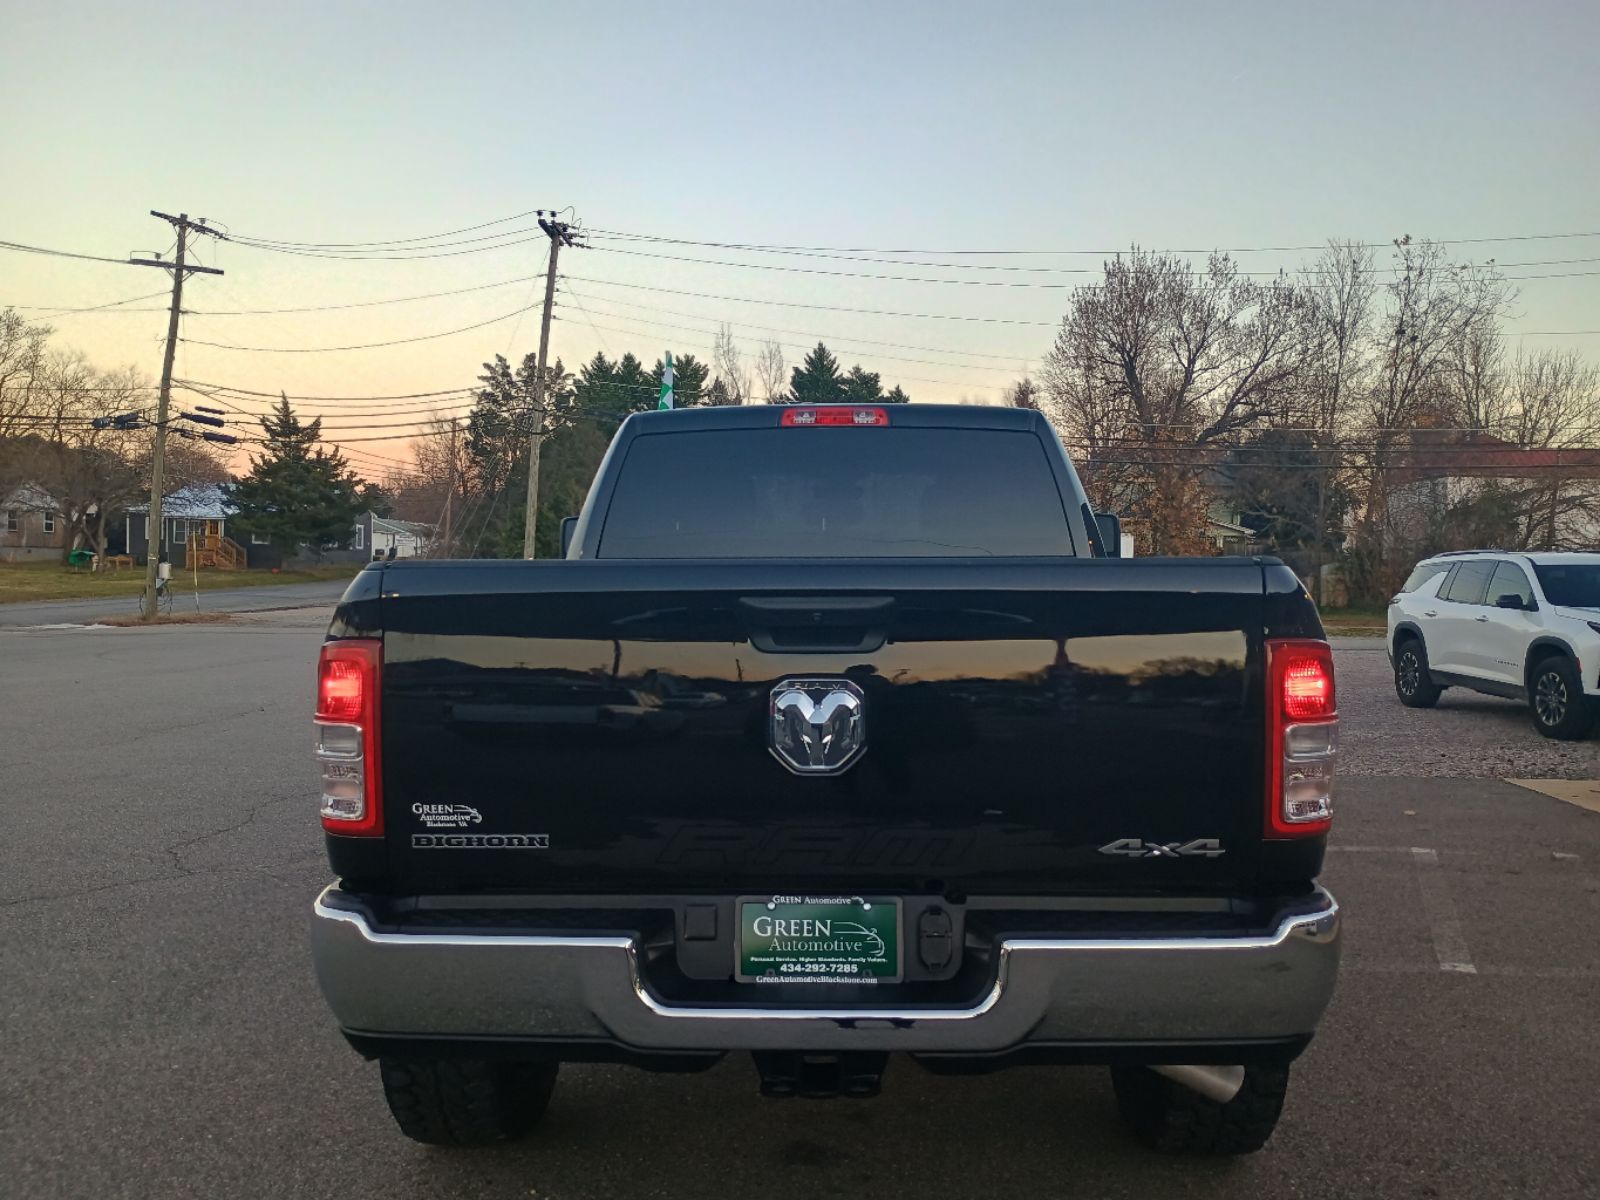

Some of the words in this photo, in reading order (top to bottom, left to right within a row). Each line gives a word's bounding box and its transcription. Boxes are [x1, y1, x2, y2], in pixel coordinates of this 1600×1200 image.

[412, 803, 454, 814] GREEN
[420, 813, 471, 821] Automotive
[411, 834, 549, 848] BIGHORN
[1097, 838, 1226, 858] 4x4
[772, 895, 802, 904] GREEN
[804, 896, 852, 905] Automotive
[753, 916, 832, 937] GREEN
[768, 937, 863, 952] Automotive
[780, 963, 858, 973] 434-292-7285
